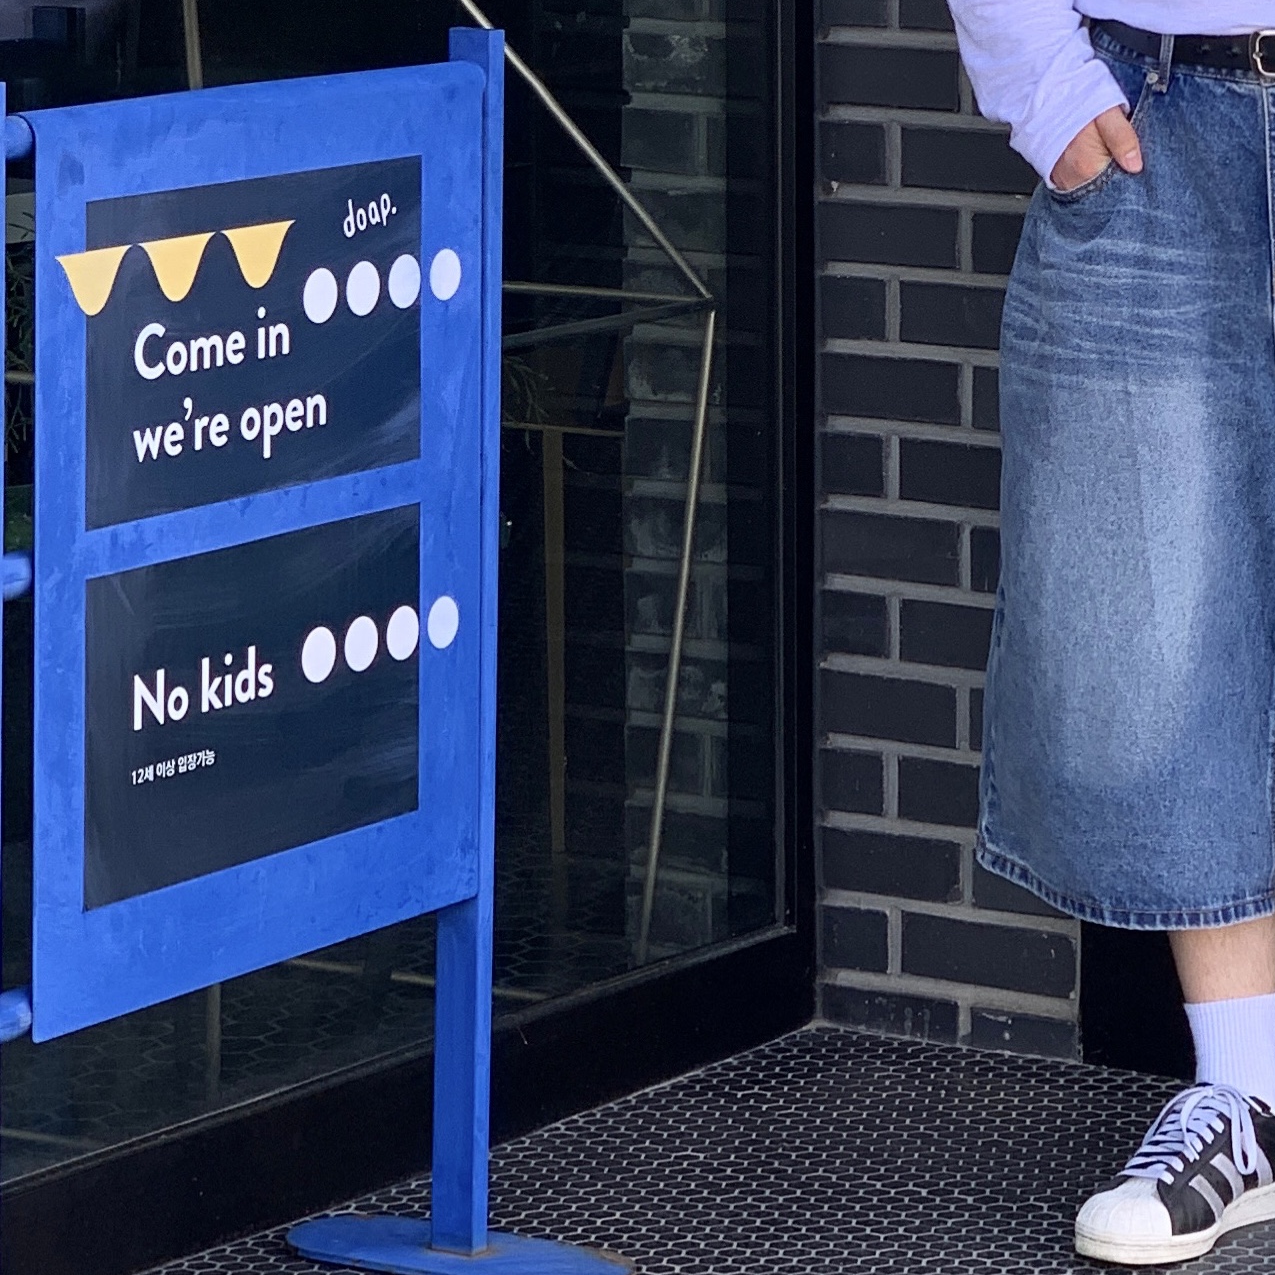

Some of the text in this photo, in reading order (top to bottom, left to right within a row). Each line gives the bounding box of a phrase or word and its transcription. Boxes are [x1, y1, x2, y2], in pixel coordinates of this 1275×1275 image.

[343, 193, 397, 238] doap.
[134, 306, 290, 380] Come in
[133, 394, 327, 463] we're open
[133, 645, 274, 731] No kids
[131, 749, 216, 785] 12세 이상 입장가능
